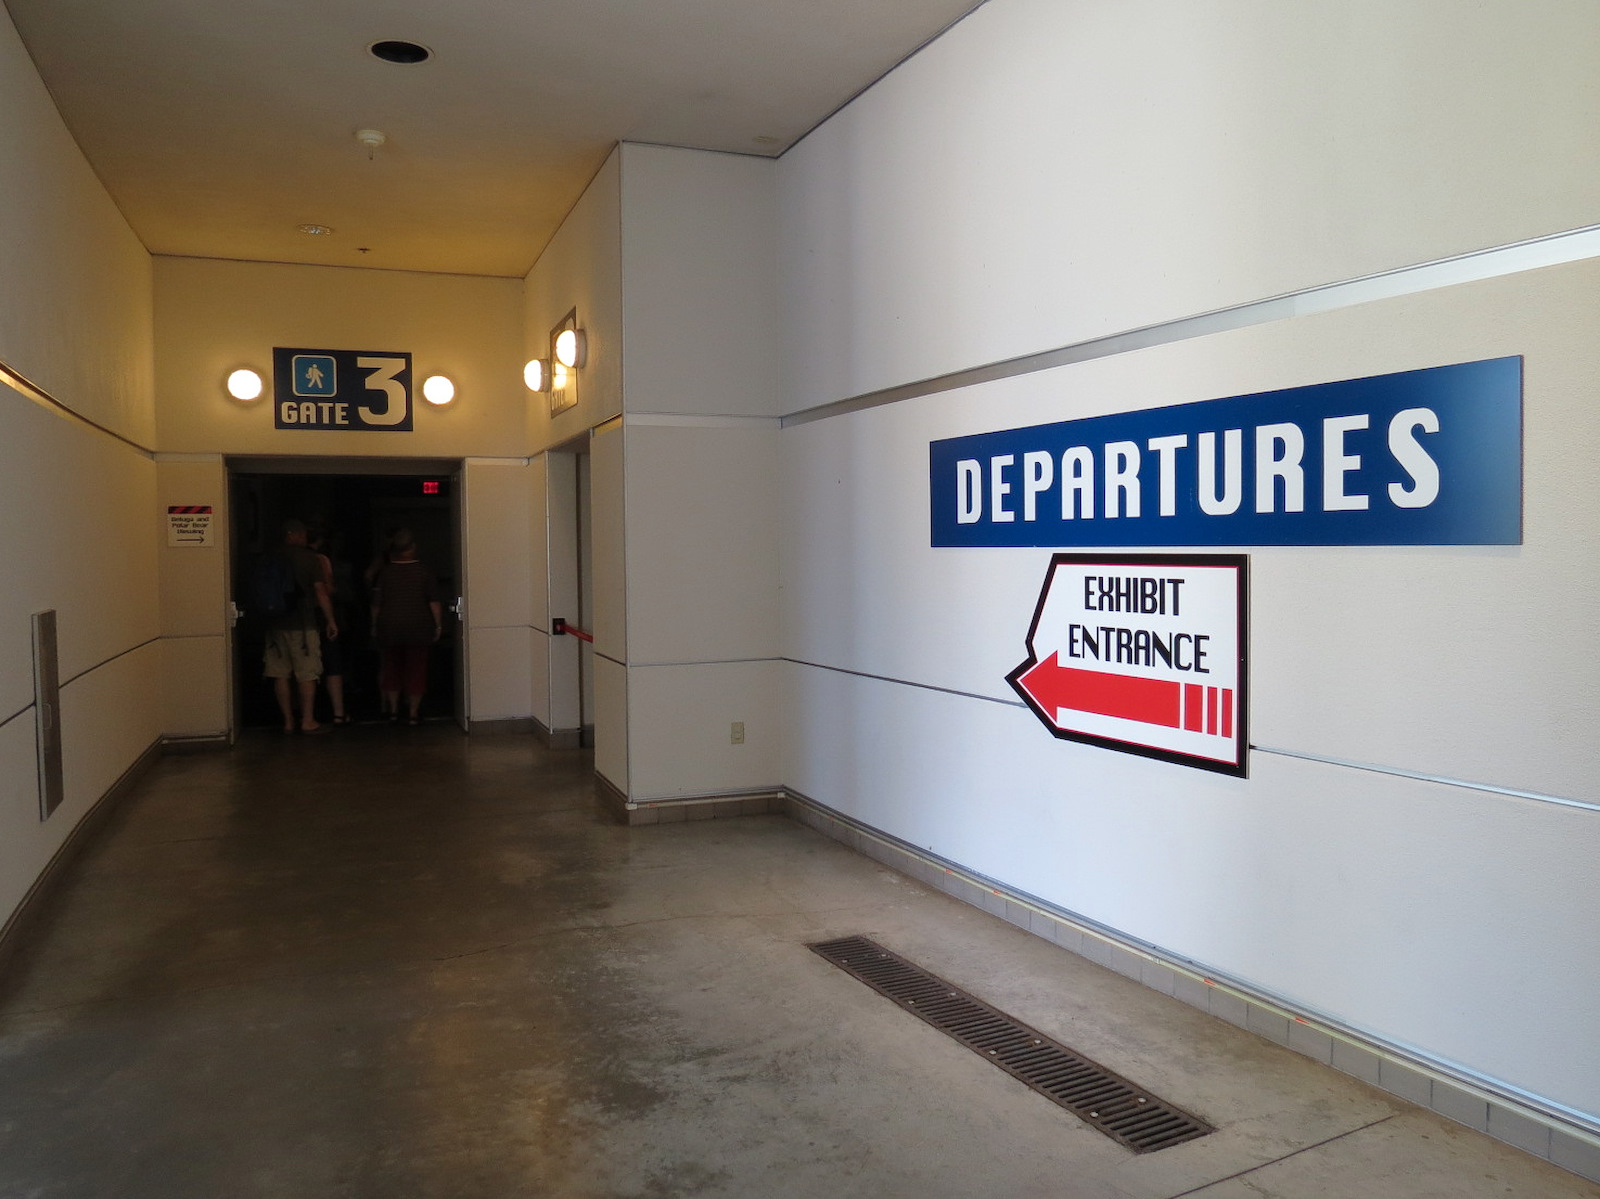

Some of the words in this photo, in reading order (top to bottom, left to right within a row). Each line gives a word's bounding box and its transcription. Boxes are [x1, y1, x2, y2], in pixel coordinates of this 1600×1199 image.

[281, 401, 349, 425] GATE
[356, 356, 407, 426] 3
[956, 407, 1441, 525] DEPARTURES
[1084, 575, 1185, 617] EXHIBIT
[1068, 624, 1210, 675] ENTRANCE
